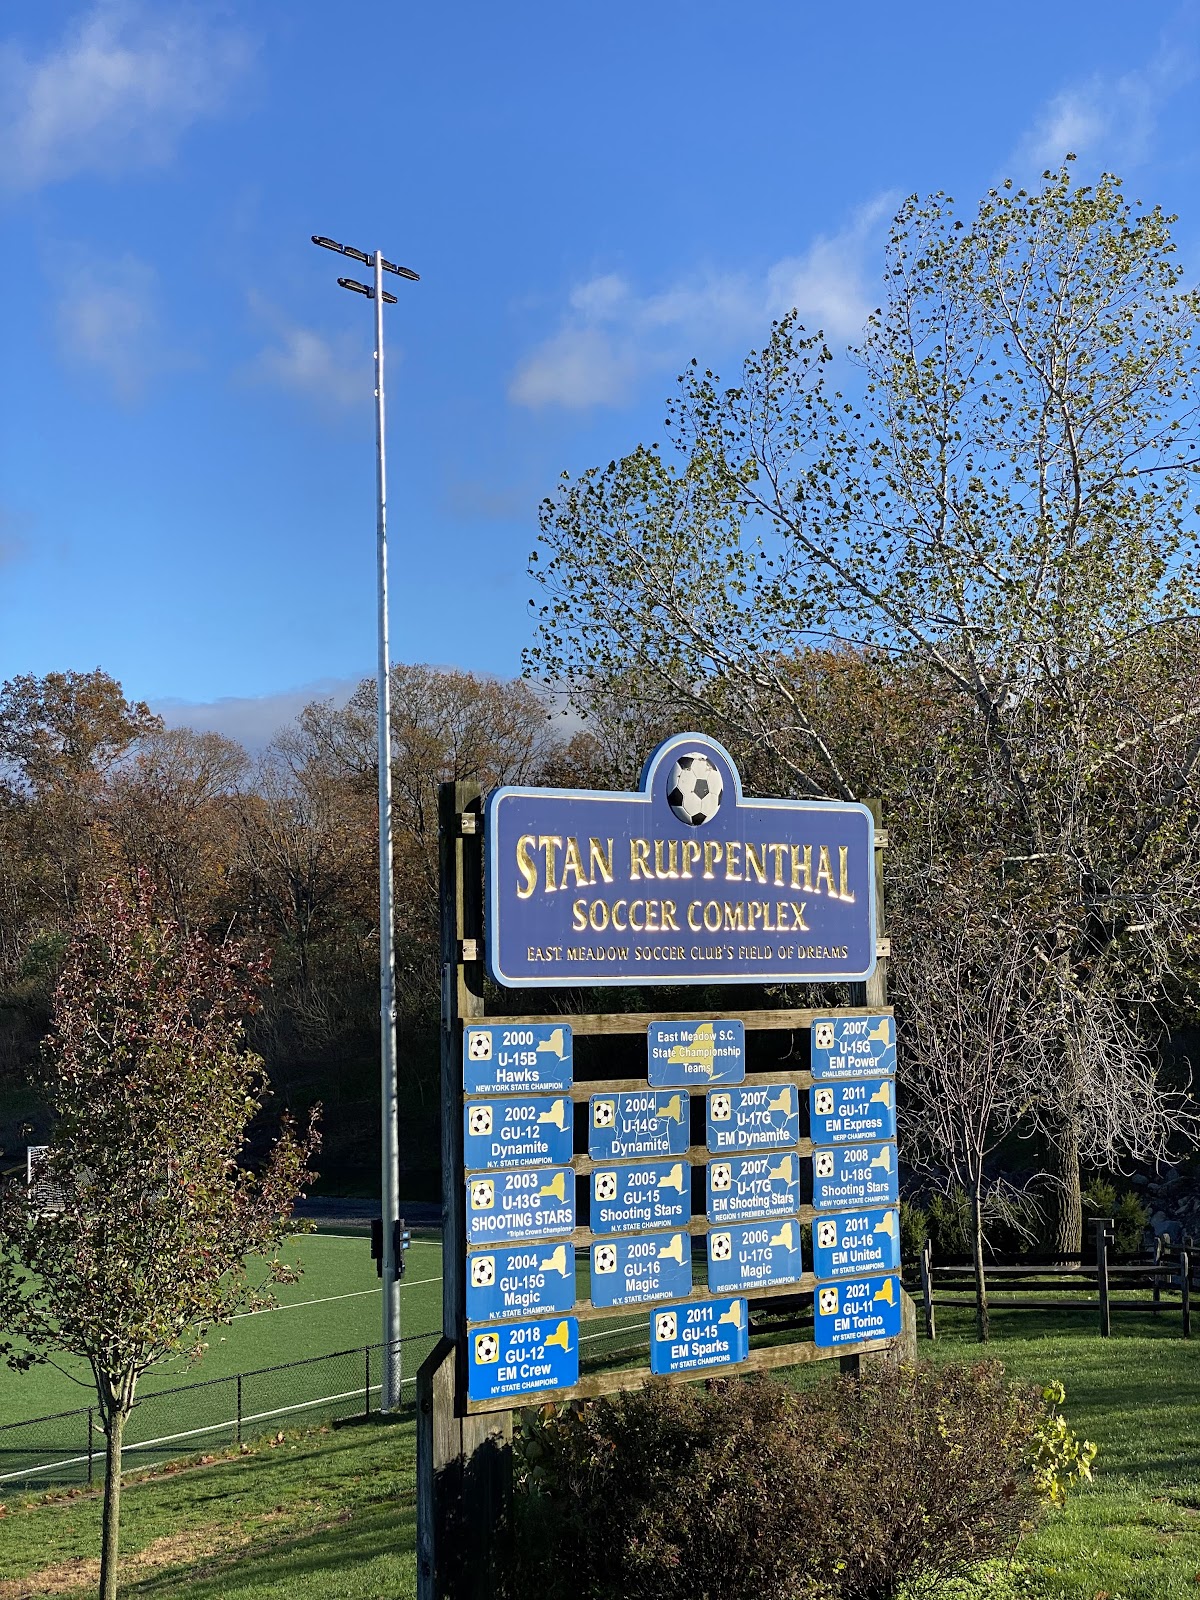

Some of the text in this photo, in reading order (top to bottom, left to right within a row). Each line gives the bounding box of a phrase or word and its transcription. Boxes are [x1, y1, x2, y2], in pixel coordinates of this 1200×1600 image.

[516, 834, 855, 903] STAN RUPPENTHAL
[572, 899, 810, 932] SOCCER COMPLEX
[527, 944, 848, 961] EAST MEADOW SOCCER CLUB'S FIELD OF DREAMS
[843, 1021, 867, 1035] 2007
[502, 1031, 534, 1045] 2000
[657, 1030, 736, 1042] East Meadow S.C.
[652, 1045, 741, 1059] State Championship
[840, 1041, 870, 1054] U-15G
[498, 1051, 537, 1066] U-15B
[829, 1055, 878, 1069] EM Power
[496, 1068, 540, 1083] Hawks
[683, 1063, 711, 1073] Teams
[475, 1082, 563, 1092] NEW YORK STATE CHAMPION
[842, 1086, 865, 1100] 2011
[625, 1098, 655, 1112] 2004
[741, 1092, 767, 1106] 2007
[504, 1106, 536, 1121] 2002
[838, 1103, 870, 1117] GU-17
[622, 1118, 658, 1133] U-14G
[737, 1111, 771, 1126] U-17G
[826, 1118, 882, 1132] EM Express
[500, 1125, 540, 1140] GU-12
[717, 1128, 790, 1146] EM Dynamite
[847, 1131, 877, 1139] CHAMPIONS
[491, 1140, 549, 1159] Dynamite
[611, 1138, 669, 1156] Dynamite
[500, 1159, 520, 1167] STATE
[520, 1156, 553, 1166] CHAMPION
[843, 1149, 868, 1163] 2008
[741, 1160, 768, 1175] 2007
[840, 1168, 872, 1182] U-18G
[505, 1173, 538, 1190] 2003
[627, 1171, 656, 1187] 2005
[737, 1179, 771, 1195] U-17G
[821, 1182, 889, 1197] Shooting Stars
[502, 1193, 541, 1211] U-13G
[623, 1189, 660, 1205] GU-15
[713, 1193, 794, 1211] EM Shooting Stars
[864, 1195, 890, 1203] CHAMPION
[471, 1209, 573, 1232] SHOOTING STARS
[600, 1204, 682, 1222] Shooting Stars
[715, 1213, 736, 1221] REGION
[741, 1210, 765, 1218] PREMIER
[765, 1207, 793, 1215] CHAMPION
[622, 1222, 641, 1231] STATE
[641, 1220, 672, 1229] CHAMPION
[845, 1217, 869, 1232] 2011
[742, 1229, 769, 1245] 2006
[841, 1234, 873, 1249] GU-16
[627, 1242, 656, 1259] 2005
[739, 1248, 773, 1263] U-17G
[832, 1247, 882, 1265] EM United
[507, 1254, 538, 1270] 2004
[624, 1261, 660, 1277] GU-16
[839, 1266, 855, 1274] STATE
[855, 1262, 885, 1271] CHAMPIONS
[741, 1263, 772, 1279] Magic
[499, 1274, 545, 1292] GU-15G
[625, 1276, 659, 1293] Magic
[716, 1284, 738, 1292] REGION
[743, 1279, 767, 1289] PREMIER
[767, 1276, 795, 1285] CHAMPION
[504, 1290, 541, 1307] Magic
[624, 1295, 642, 1304] STATE
[642, 1291, 673, 1302] CHAMPION
[846, 1283, 870, 1299] 2021
[489, 1305, 555, 1319] N.Y. STATE CHAMPION
[686, 1306, 713, 1323] 2011
[843, 1300, 873, 1316] GU-11
[834, 1315, 883, 1331] EM Torino
[509, 1327, 541, 1345] 2018
[682, 1324, 718, 1342] GU-15
[856, 1328, 886, 1338] CHAMPIONS
[505, 1345, 545, 1364] GU-12
[671, 1339, 729, 1359] EM Sparks
[670, 1354, 730, 1370] NY STATE CHAMPIONS
[497, 1364, 552, 1382] EM Crew
[490, 1377, 558, 1394] NY STATE CHAMPIONS
